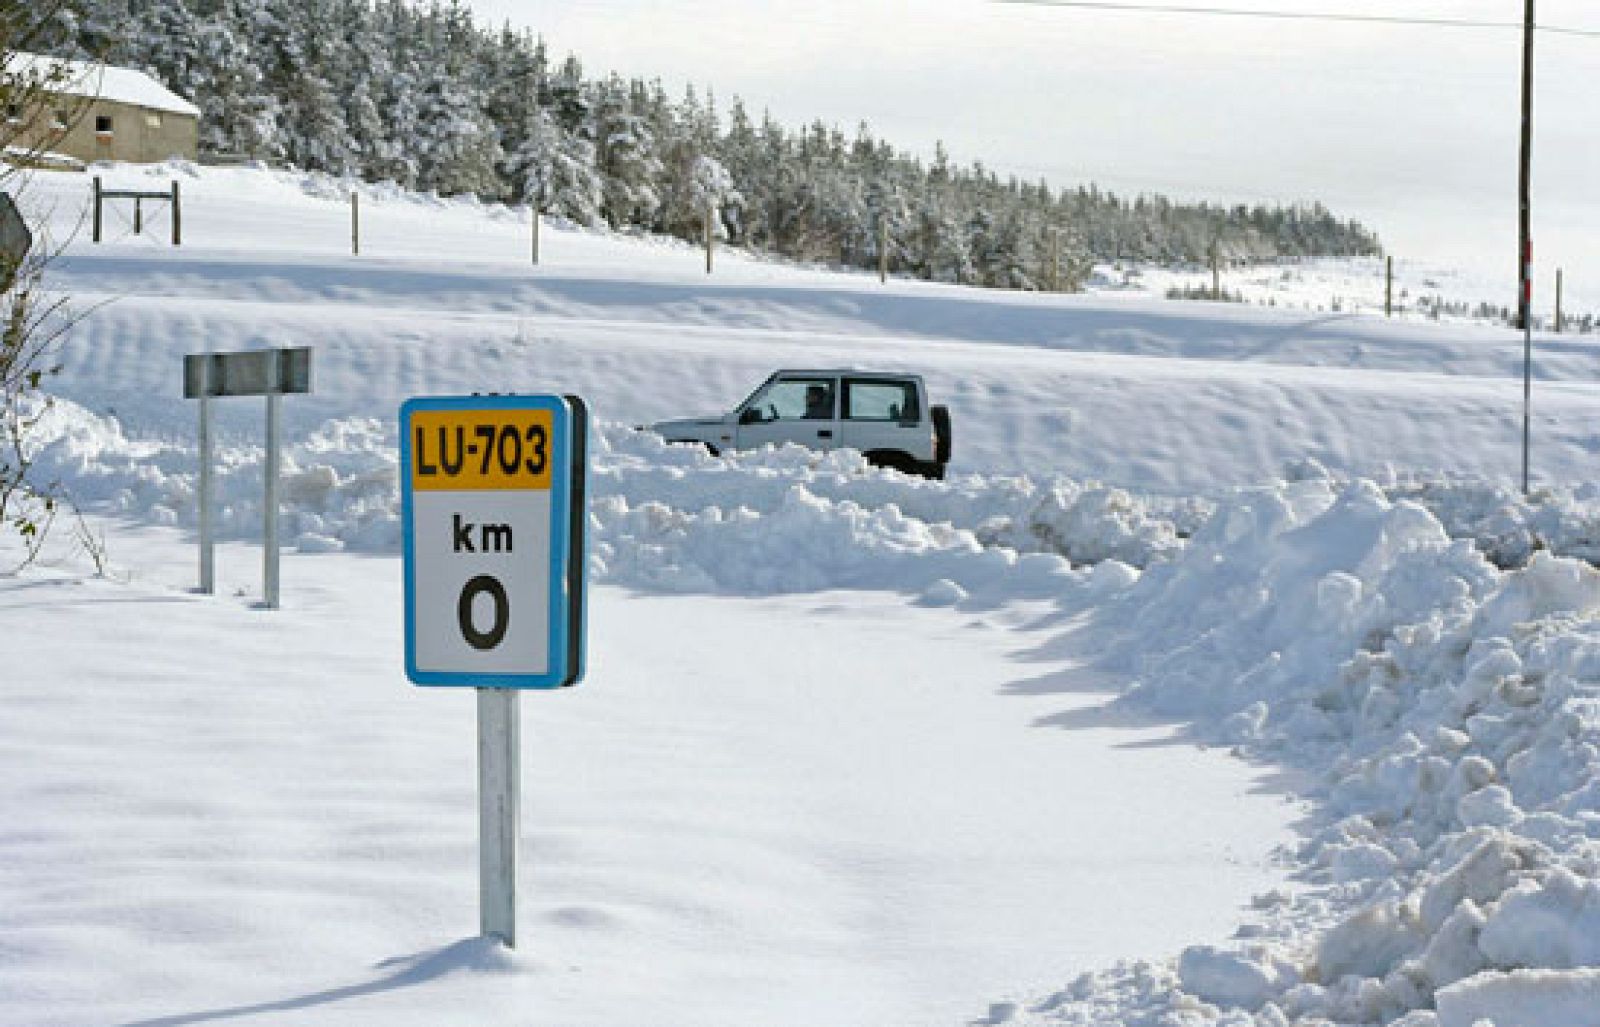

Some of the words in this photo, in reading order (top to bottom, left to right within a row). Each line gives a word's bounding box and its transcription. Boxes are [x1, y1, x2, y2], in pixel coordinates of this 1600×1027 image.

[415, 423, 547, 477] LU-703
[452, 512, 513, 554] km
[458, 573, 510, 650] 0
